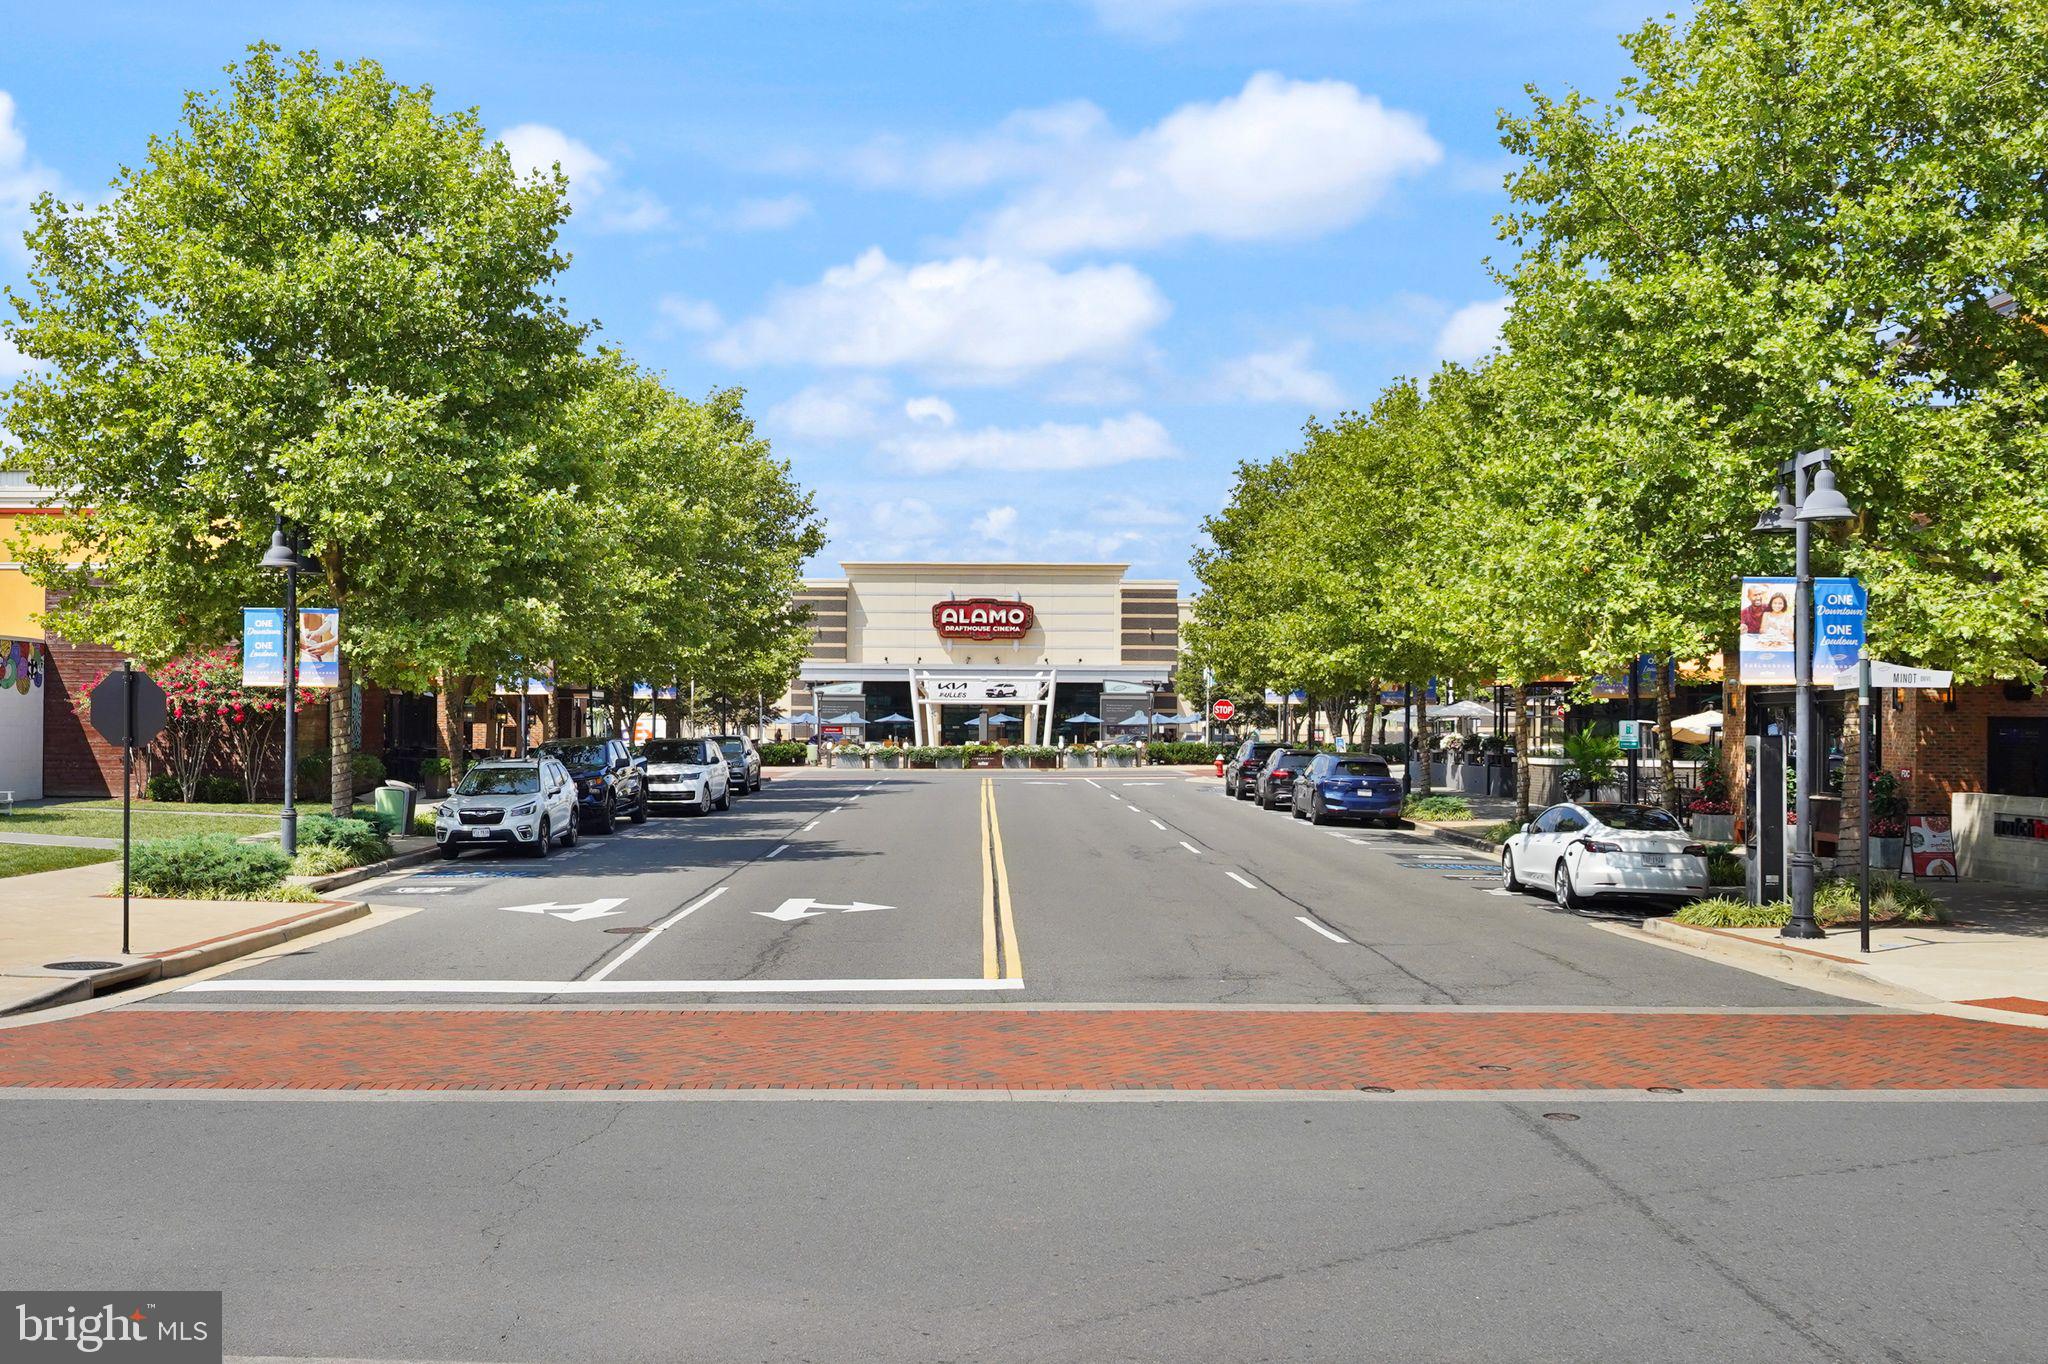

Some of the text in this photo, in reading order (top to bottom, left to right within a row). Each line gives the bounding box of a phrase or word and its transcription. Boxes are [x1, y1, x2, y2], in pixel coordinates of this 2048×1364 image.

[1827, 594, 1853, 606] ONE
[1817, 605, 1863, 616] Downtown
[941, 608, 1025, 625] ALAMO
[1826, 624, 1852, 636] ONE
[1820, 635, 1859, 647] Loudoun
[1893, 673, 1918, 684] MINOT
[1215, 706, 1232, 714] STOP
[1901, 769, 1910, 778] FDC
